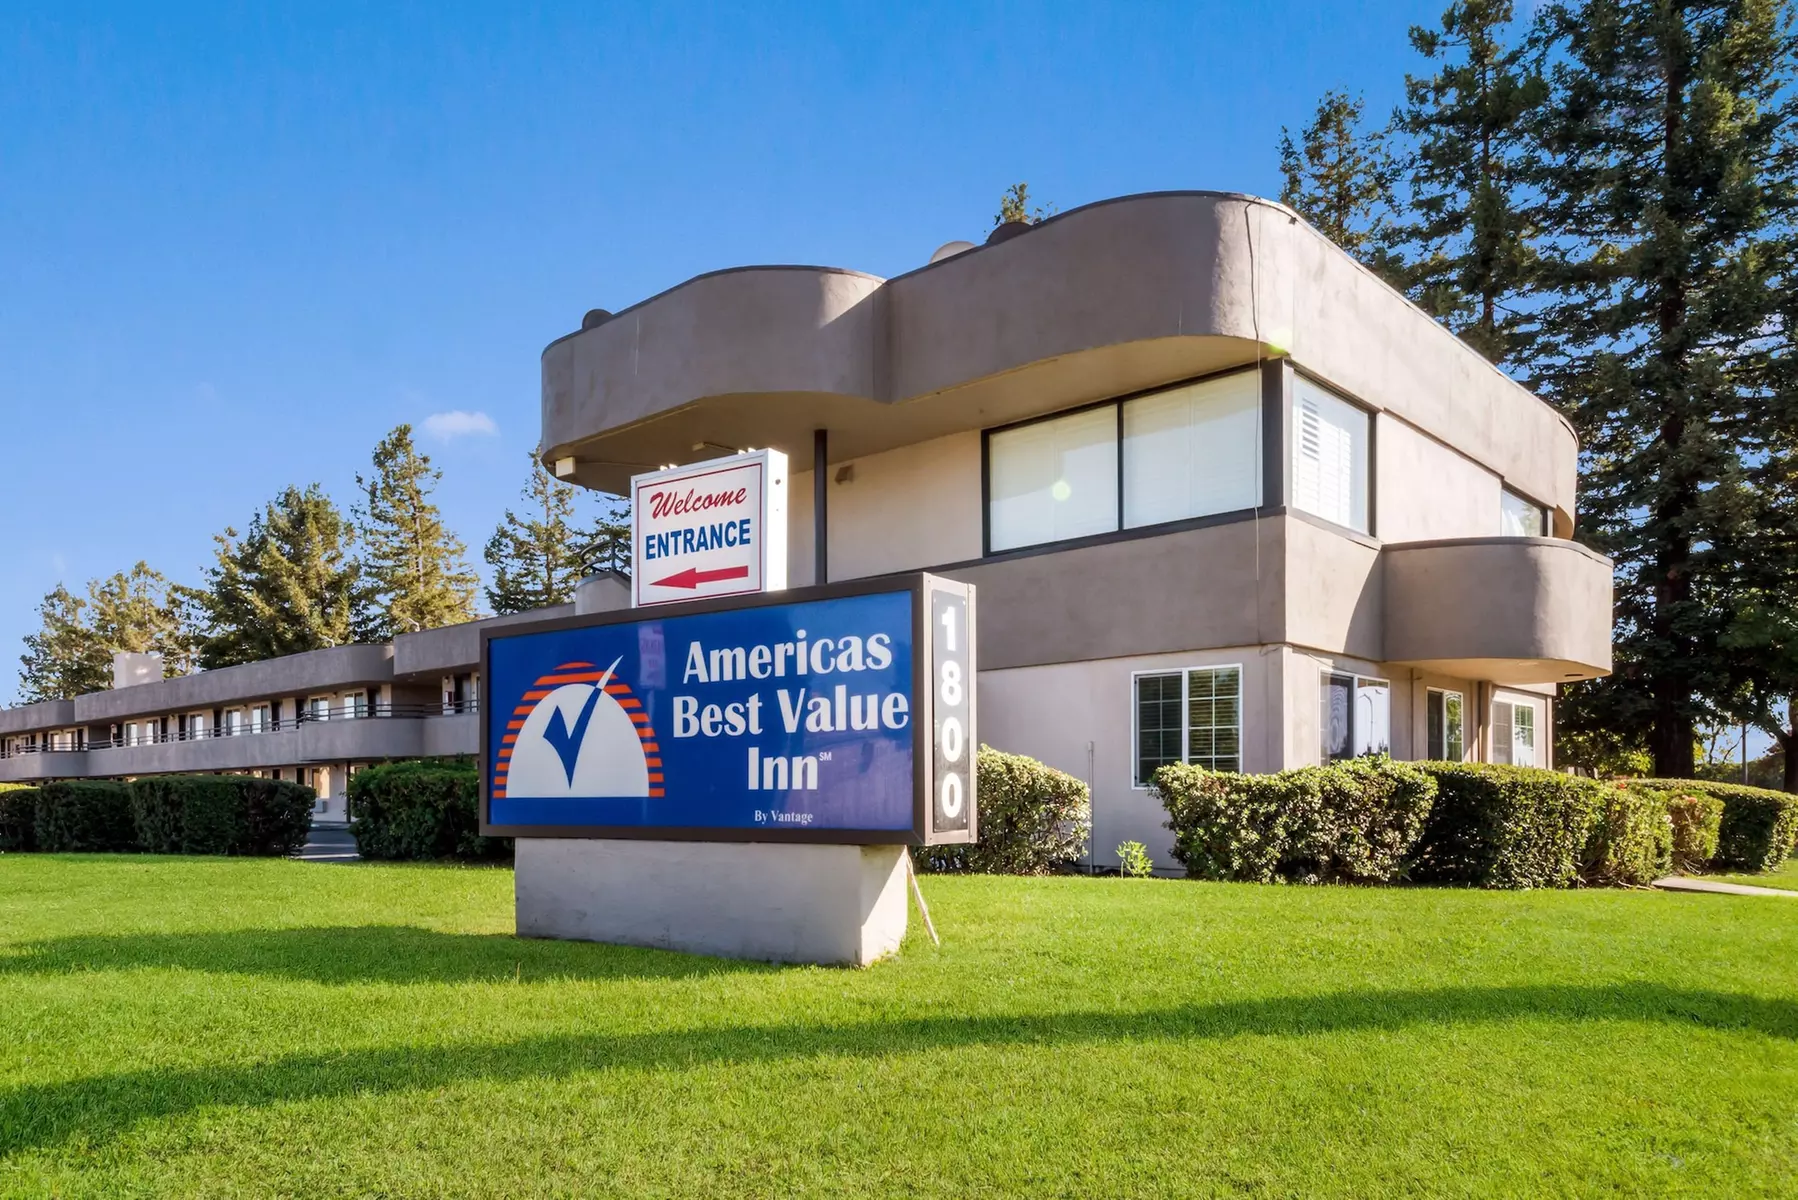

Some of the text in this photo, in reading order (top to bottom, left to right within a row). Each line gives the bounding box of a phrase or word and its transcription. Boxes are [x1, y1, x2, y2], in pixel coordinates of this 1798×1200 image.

[650, 488, 747, 519] Welcome
[645, 518, 751, 560] ENTRANCE
[683, 629, 892, 684] Americas
[673, 684, 909, 738] Best Value
[941, 606, 963, 819] 1800
[748, 746, 818, 790] Inn
[754, 809, 813, 826] By Vantage
